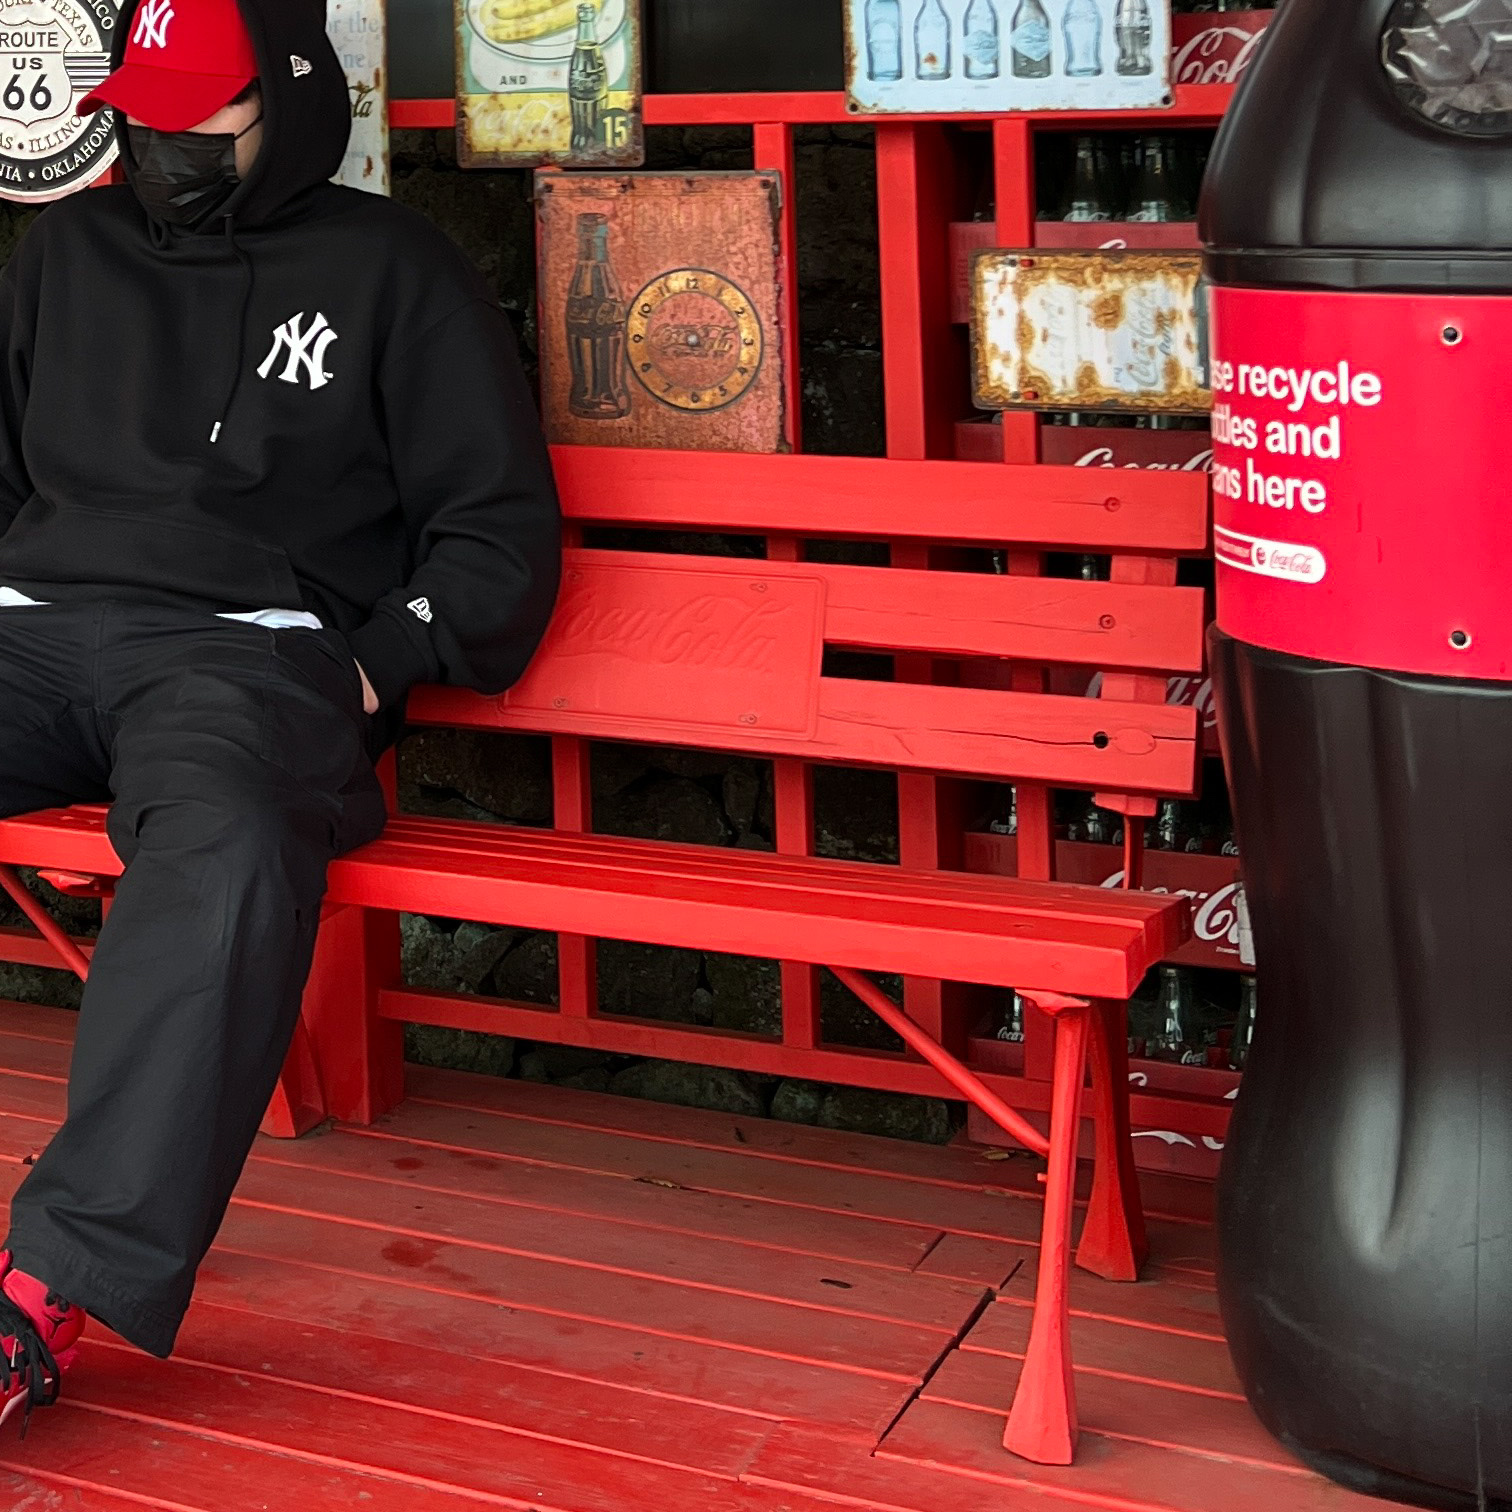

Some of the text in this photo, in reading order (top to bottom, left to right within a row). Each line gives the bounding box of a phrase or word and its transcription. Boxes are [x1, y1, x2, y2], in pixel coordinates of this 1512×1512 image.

[12, 57, 44, 70] US
[499, 75, 528, 86] AND
[2, 73, 52, 111] 66
[28, 114, 83, 154] ILLINO
[602, 116, 628, 150] 15
[41, 109, 115, 182] OKLAHOMA
[685, 277, 699, 290] 12
[638, 302, 652, 319] 10
[734, 305, 745, 317] 2
[632, 333, 644, 344] 9
[742, 337, 755, 347] 3
[256, 311, 338, 390] NY
[662, 382, 674, 393] 7
[717, 386, 728, 397] 5
[1238, 360, 1382, 412] recycle
[690, 391, 702, 403] 6
[1211, 402, 1258, 450] ttles
[1264, 415, 1341, 460] and
[1246, 457, 1327, 514] here
[1270, 549, 1315, 575] Coca-Cola
